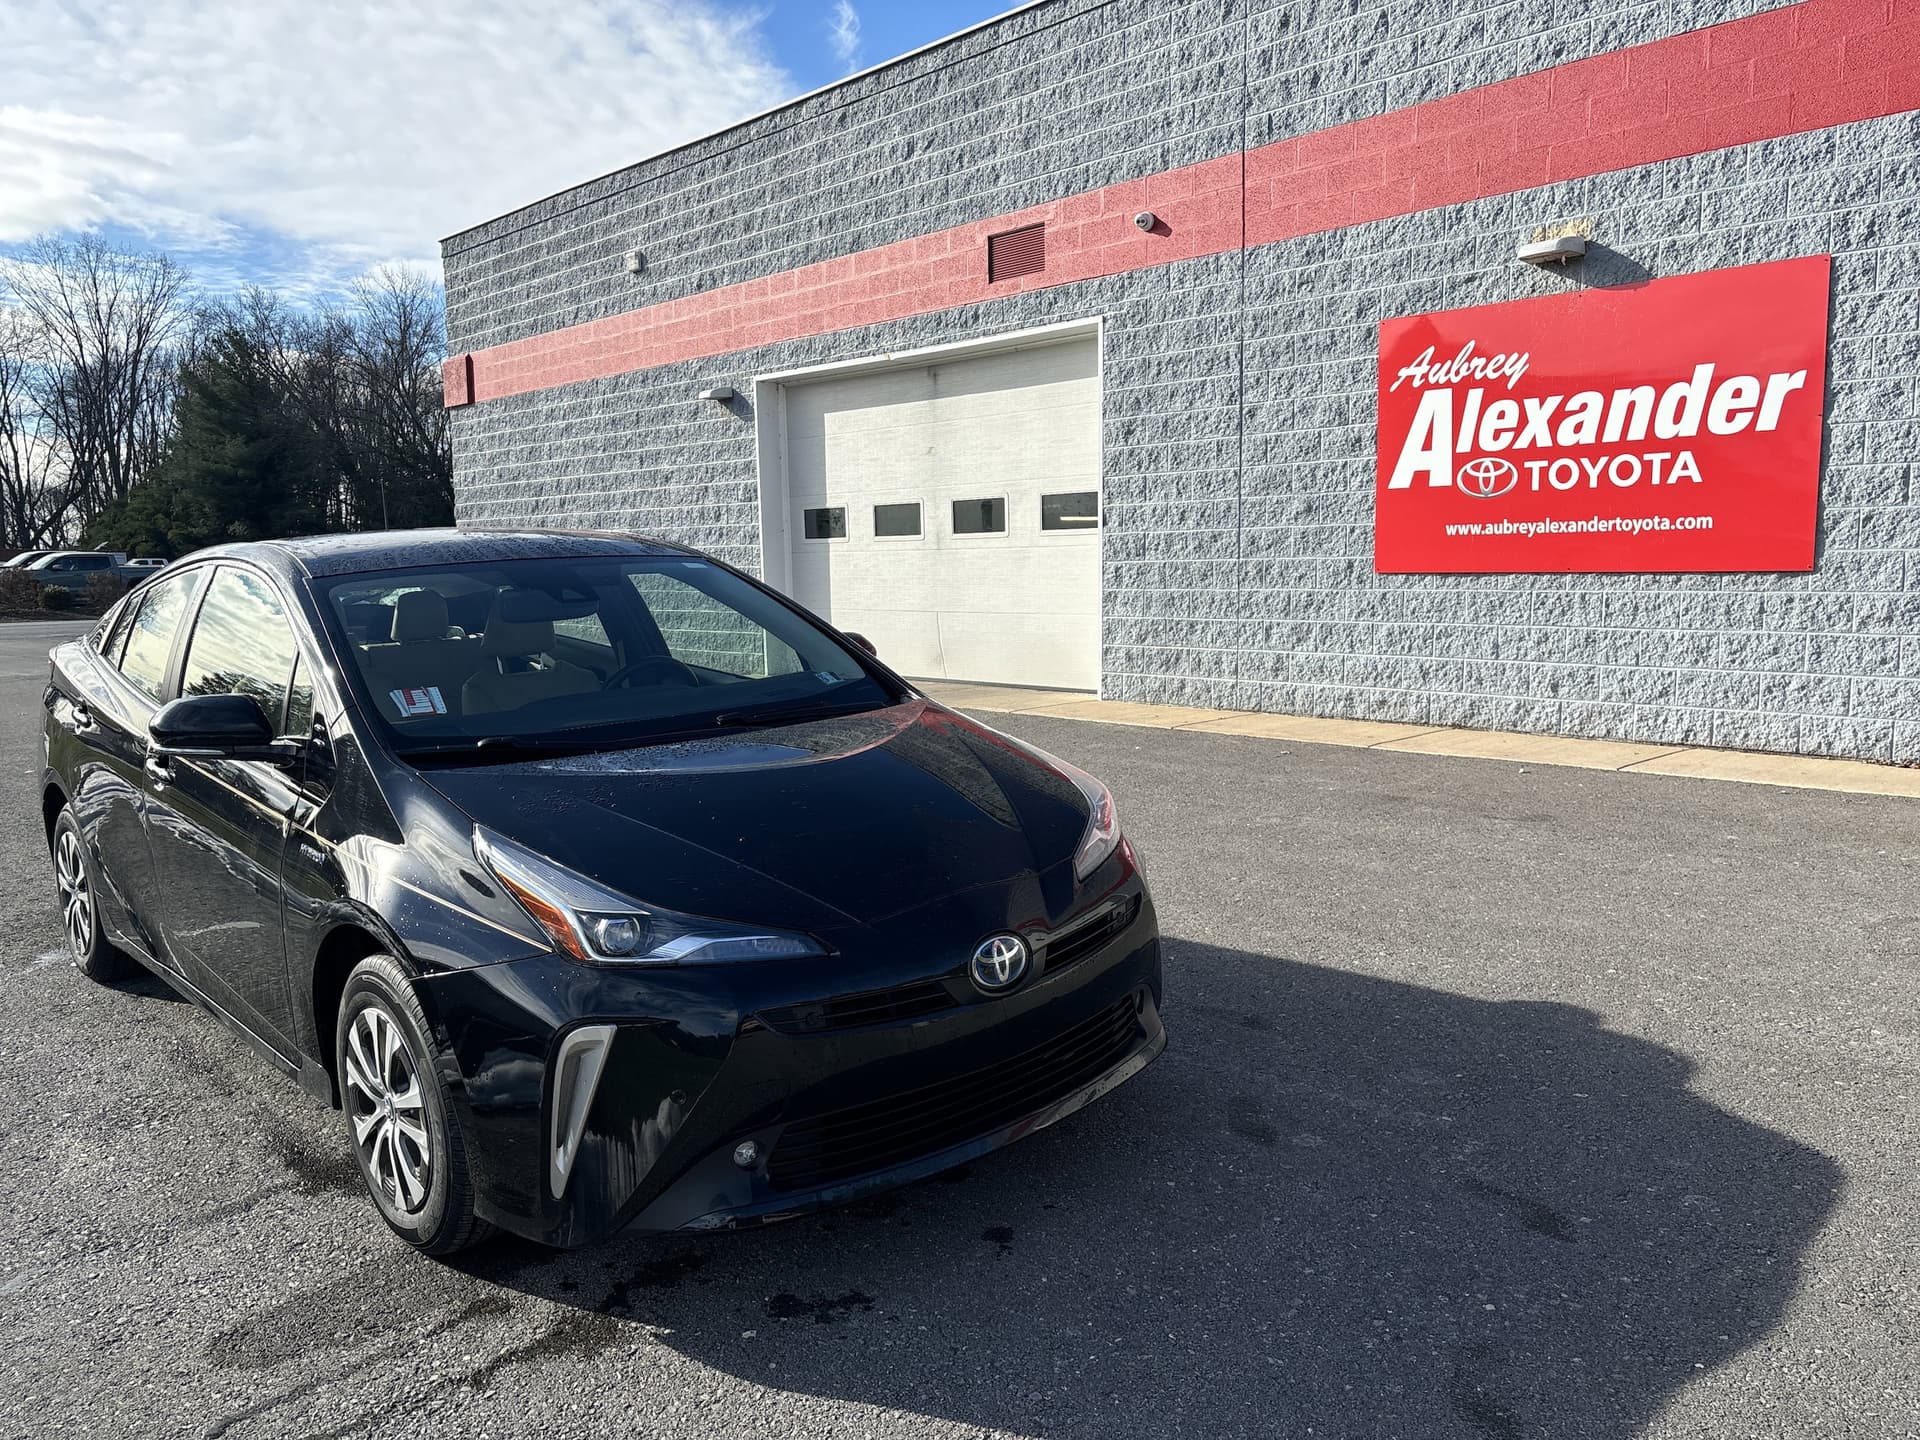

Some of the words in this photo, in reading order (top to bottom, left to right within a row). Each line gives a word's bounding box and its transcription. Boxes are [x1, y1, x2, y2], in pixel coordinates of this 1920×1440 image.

[1391, 340, 1529, 391] Aubrey
[1388, 363, 1807, 489] Alexander
[1524, 451, 1703, 491] TOYOTA
[1446, 514, 1713, 538] www.aubreyalexandertoyota.com
